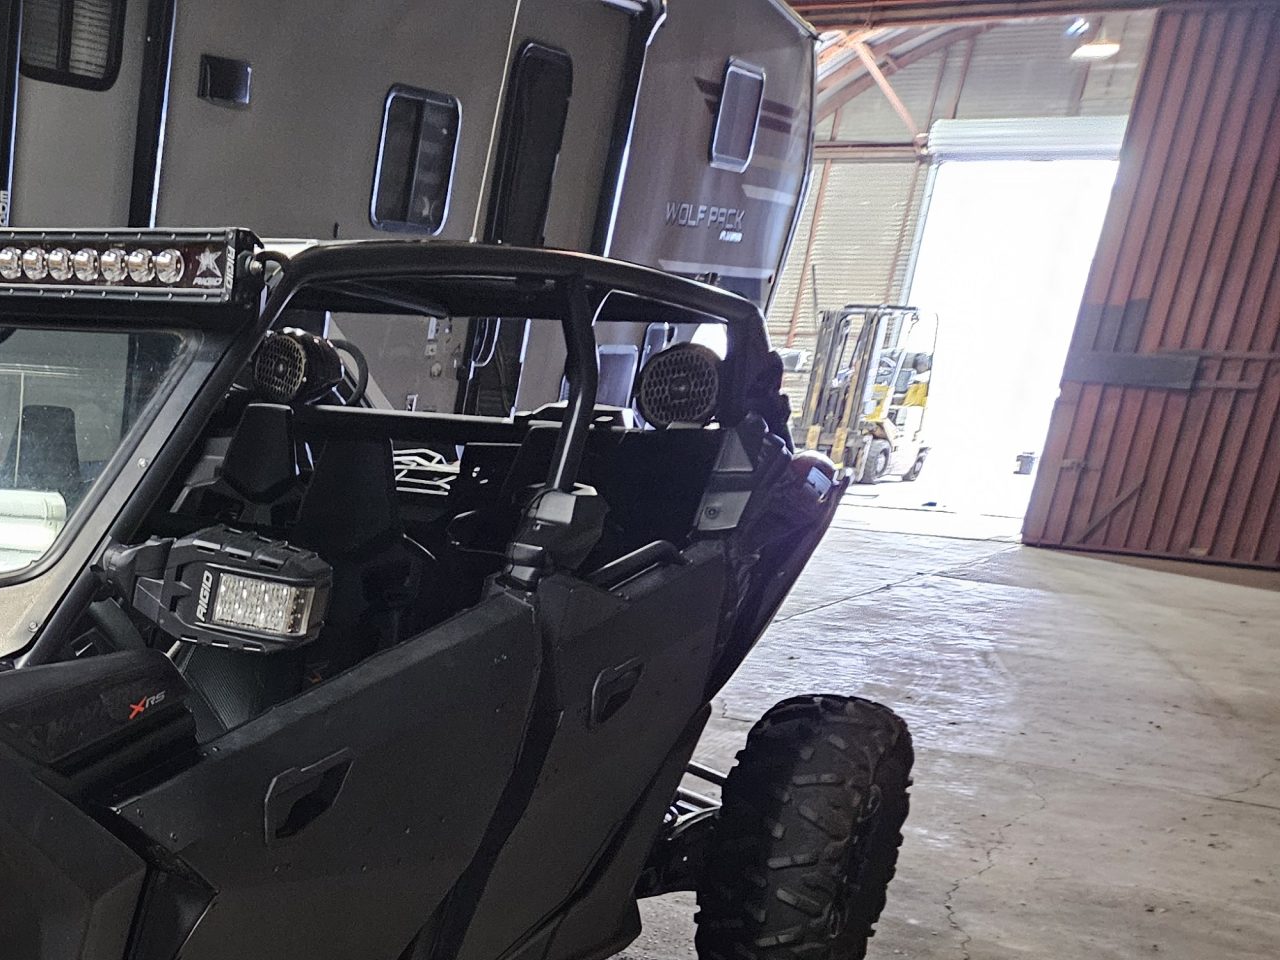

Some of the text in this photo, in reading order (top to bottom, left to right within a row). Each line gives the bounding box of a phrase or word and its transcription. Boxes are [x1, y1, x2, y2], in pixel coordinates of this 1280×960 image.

[665, 202, 745, 229] WOLF PACK
[225, 245, 236, 290] RIGID
[196, 570, 213, 622] RIGID
